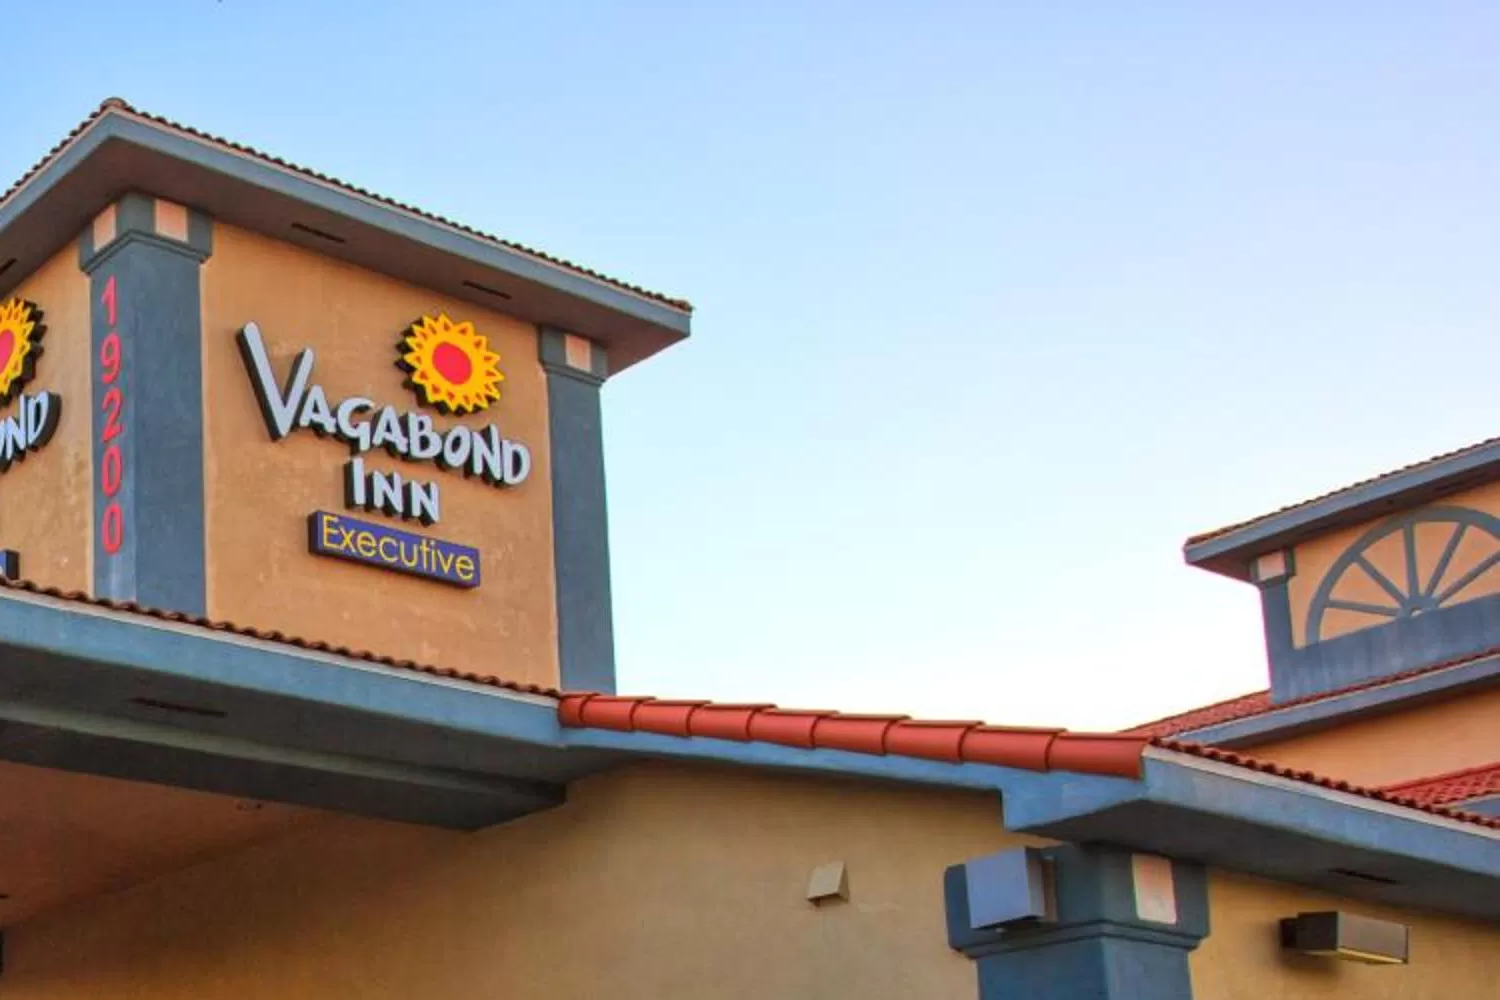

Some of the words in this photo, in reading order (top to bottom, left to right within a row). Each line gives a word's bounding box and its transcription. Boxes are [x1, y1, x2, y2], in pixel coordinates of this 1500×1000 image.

[100, 274, 124, 555] 19200
[242, 321, 531, 486] VAGABOND
[321, 514, 476, 580] Executive
[352, 457, 440, 523] INN
